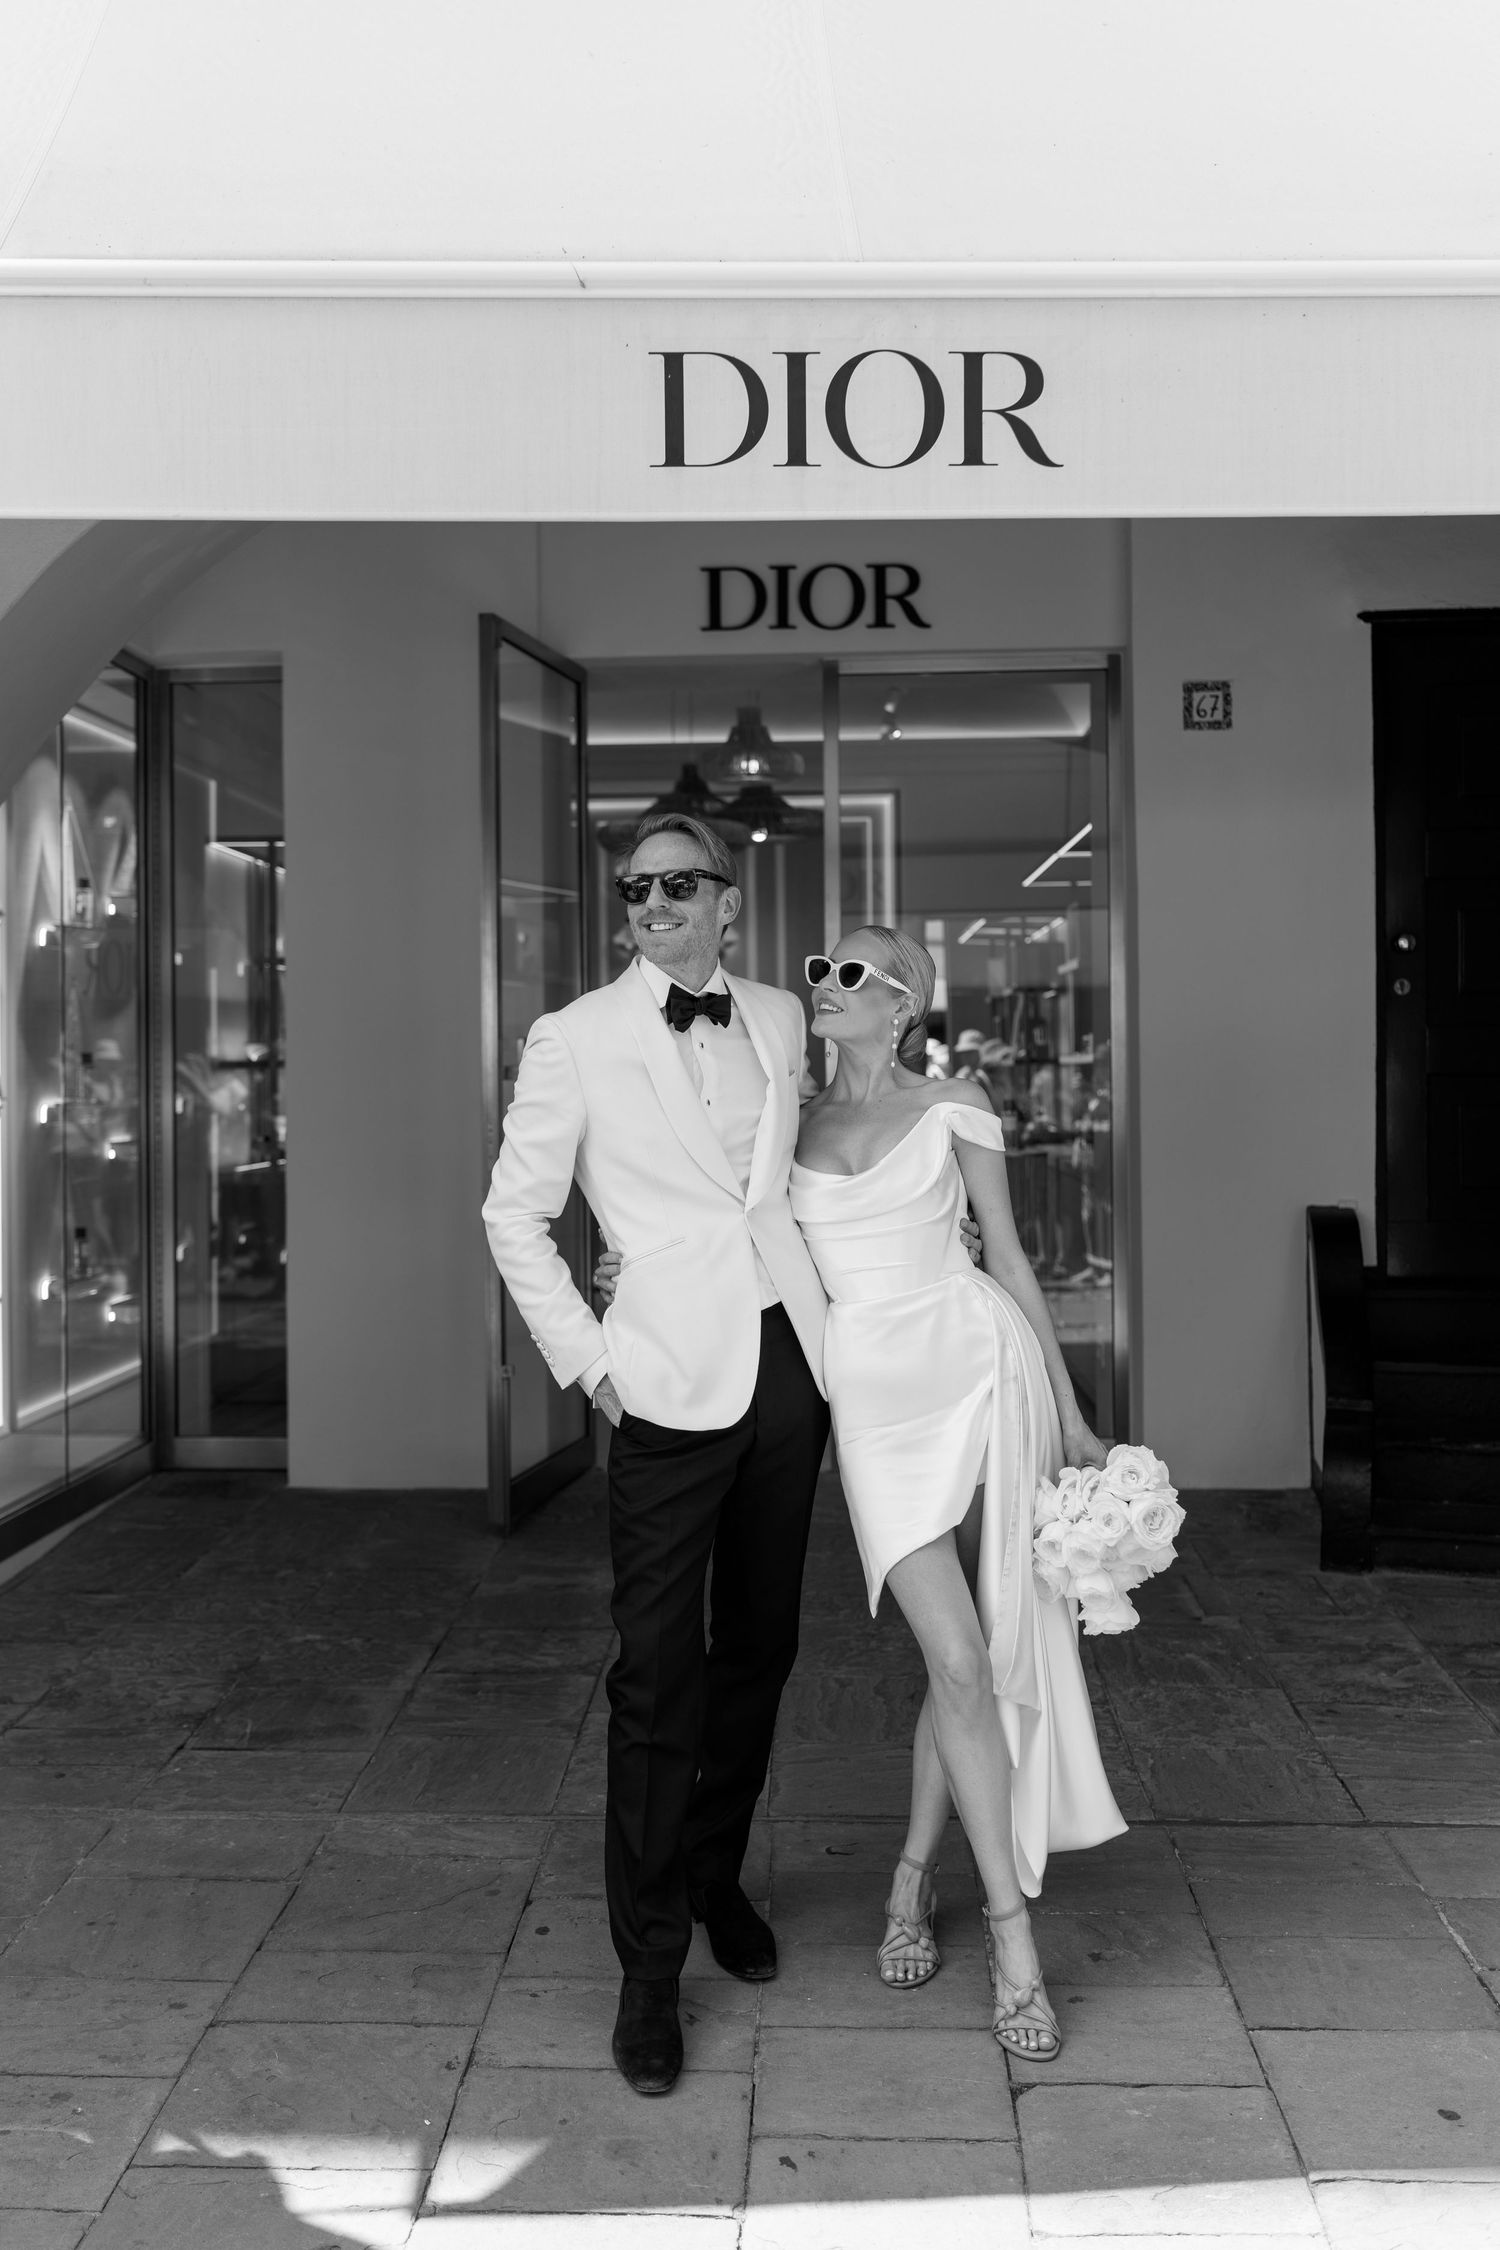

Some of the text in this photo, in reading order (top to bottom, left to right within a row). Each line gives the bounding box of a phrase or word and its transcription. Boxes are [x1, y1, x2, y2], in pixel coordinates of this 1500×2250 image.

[648, 349, 1064, 469] DIOR
[699, 562, 932, 632] DIOR
[1196, 694, 1219, 719] 67
[873, 968, 890, 982] FENDI
